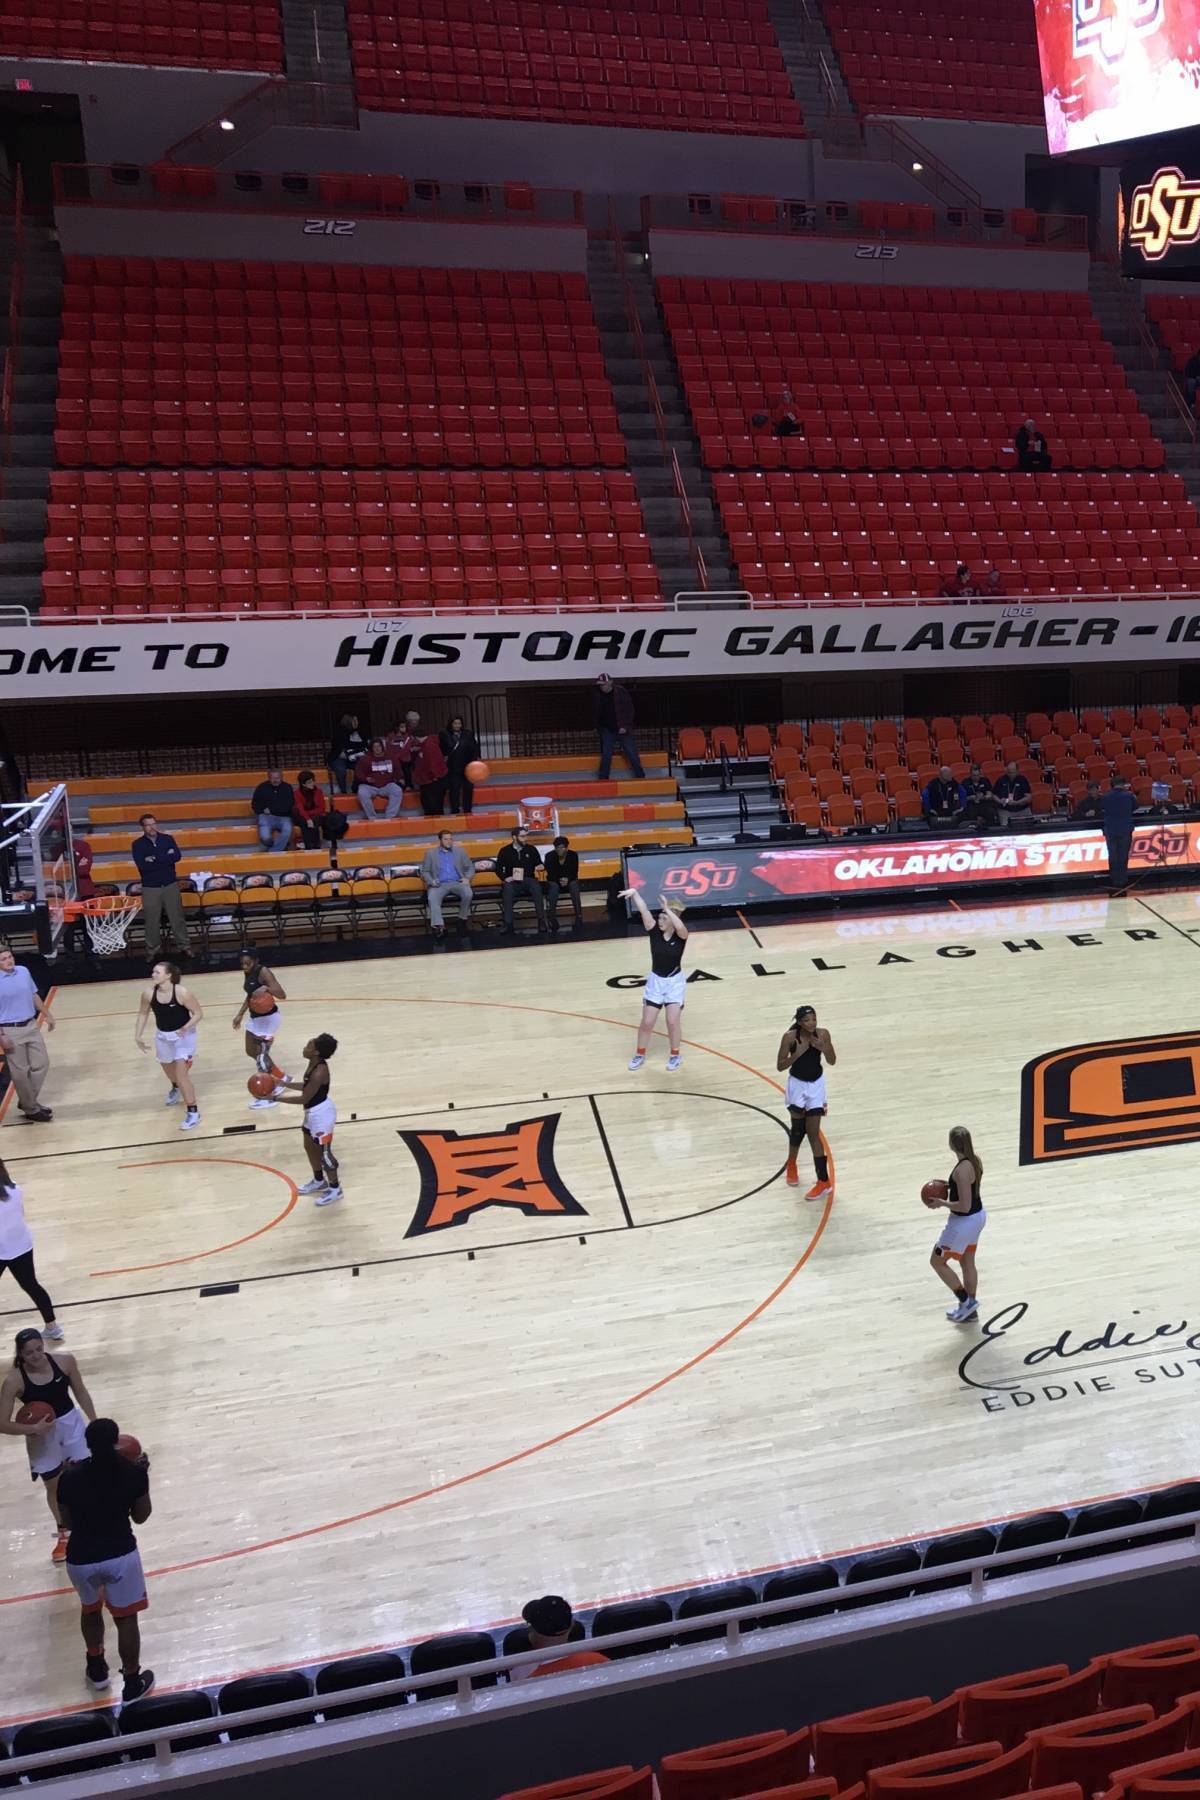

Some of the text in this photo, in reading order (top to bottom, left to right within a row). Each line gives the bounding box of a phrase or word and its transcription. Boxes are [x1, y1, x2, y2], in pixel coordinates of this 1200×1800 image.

[303, 219, 356, 235] 212
[855, 244, 899, 259] 213
[365, 620, 407, 633] 107
[1001, 606, 1038, 618] 108
[144, 643, 230, 669] TO
[334, 628, 697, 668] HISTORIC
[1129, 829, 1192, 862] OSU
[660, 859, 741, 897] OSU
[834, 849, 1018, 881] OKLAHOMA
[958, 1302, 1188, 1391] Eddie
[980, 1375, 1116, 1413] EDDIE
